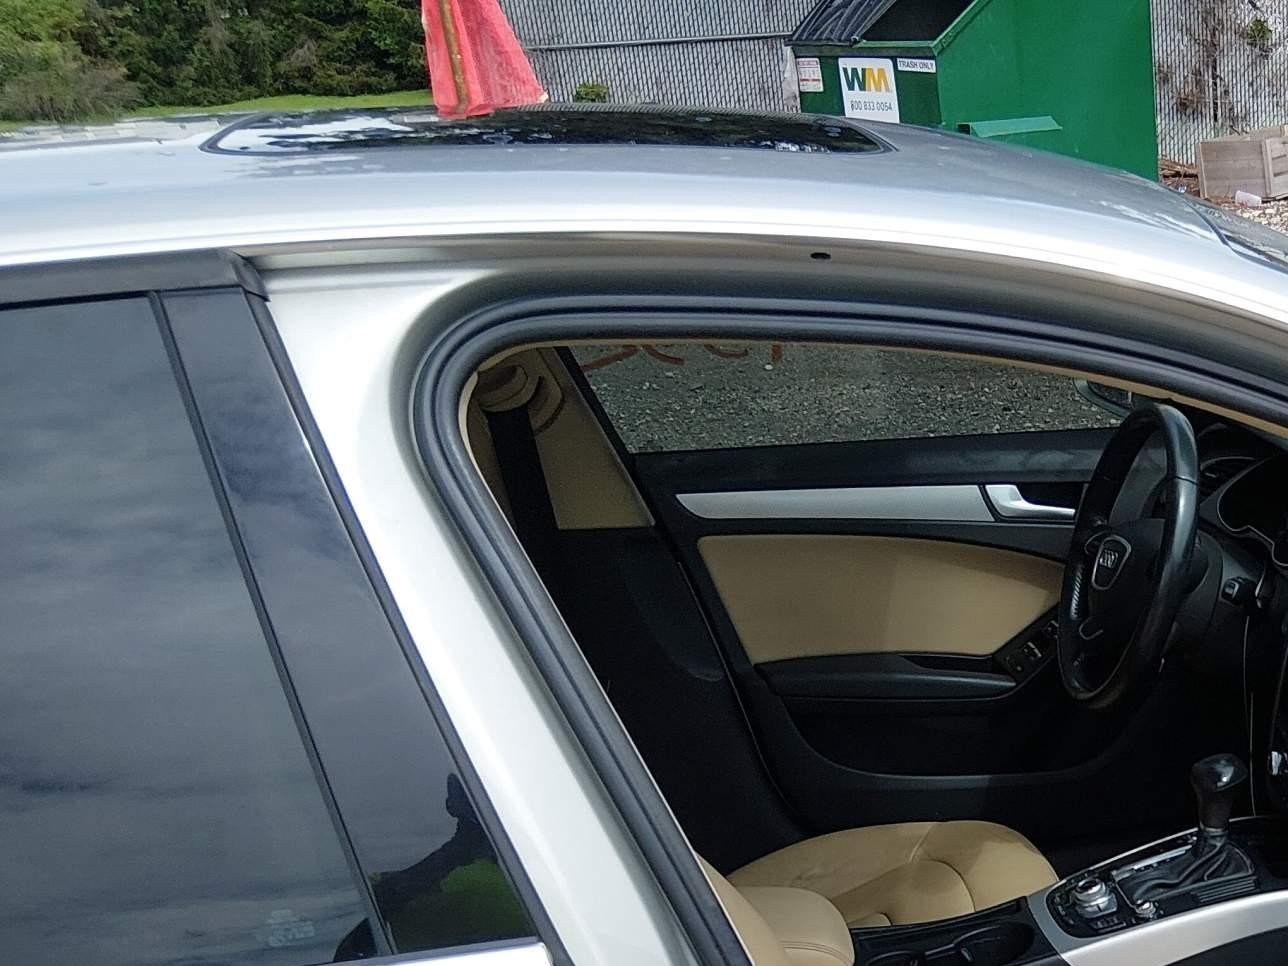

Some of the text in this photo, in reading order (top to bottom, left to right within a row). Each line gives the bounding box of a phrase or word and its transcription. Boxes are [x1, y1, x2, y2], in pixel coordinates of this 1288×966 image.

[899, 60, 934, 70] TRASH ONLY
[842, 67, 891, 92] WM
